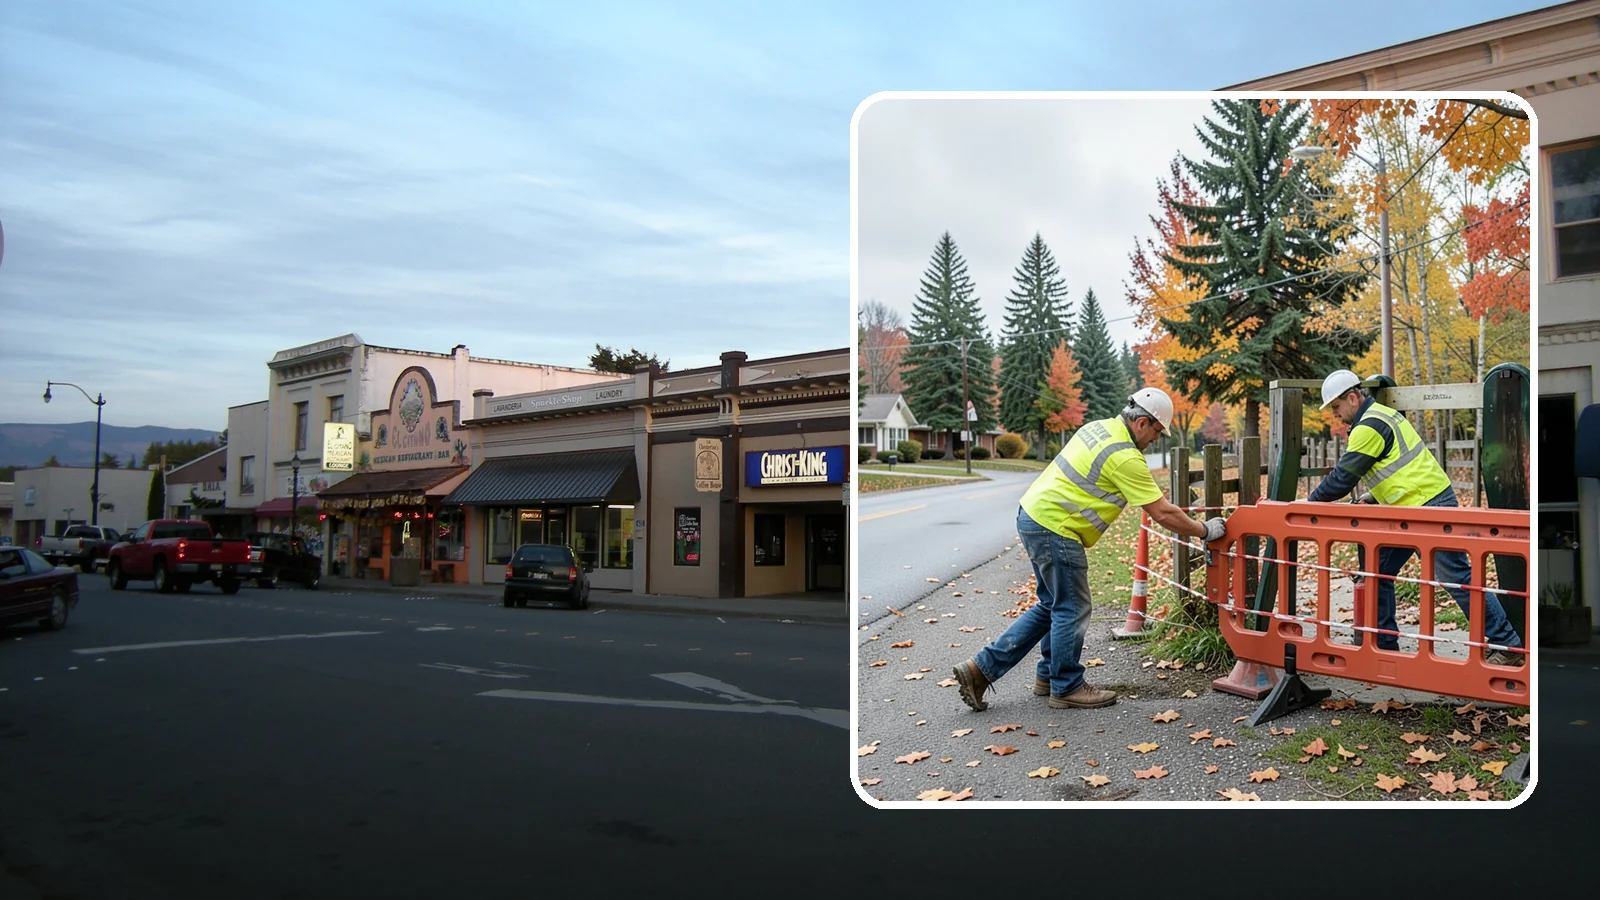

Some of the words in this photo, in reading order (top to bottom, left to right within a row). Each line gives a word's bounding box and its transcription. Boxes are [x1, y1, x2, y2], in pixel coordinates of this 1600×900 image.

[596, 389, 623, 399] LAUNDRY
[493, 402, 522, 412] LAVANDERIA
[531, 397, 561, 408] Sparkle
[562, 394, 582, 405] Shop
[397, 451, 433, 462] RESTAURANT
[438, 450, 450, 459] BAR
[761, 452, 797, 478] CHRIST
[799, 450, 827, 477] KING
